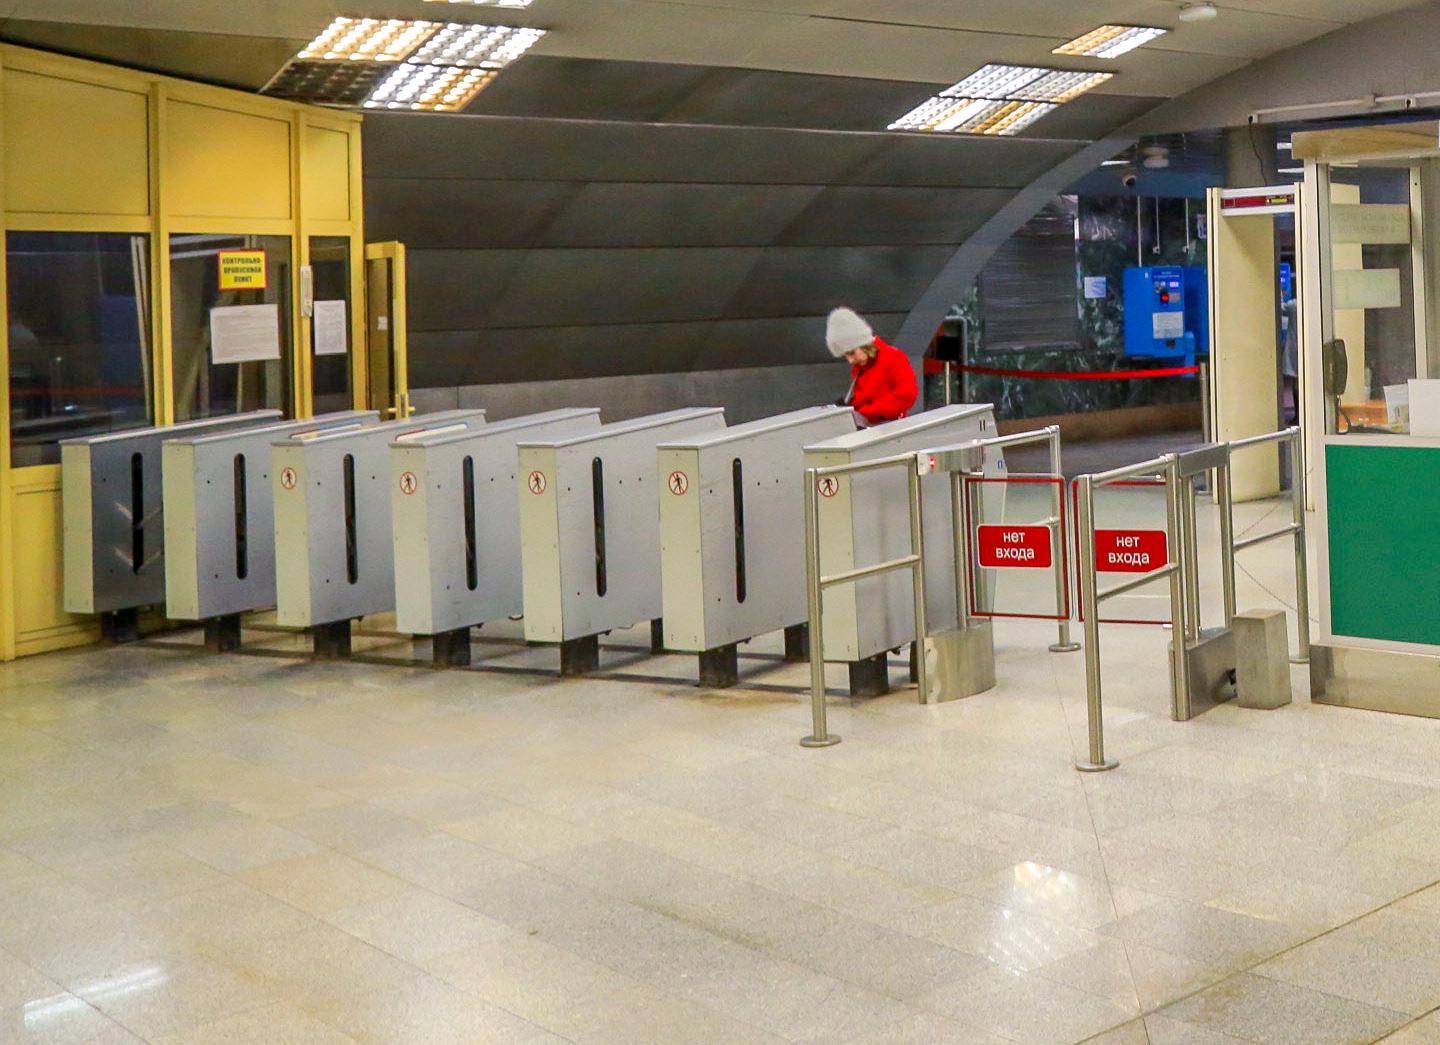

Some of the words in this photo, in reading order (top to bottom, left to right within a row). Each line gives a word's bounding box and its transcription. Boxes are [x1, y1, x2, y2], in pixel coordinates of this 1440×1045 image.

[1003, 532, 1025, 543] нет
[1116, 536, 1140, 547] нет
[995, 547, 1035, 560] входа
[1108, 552, 1150, 566] входа
